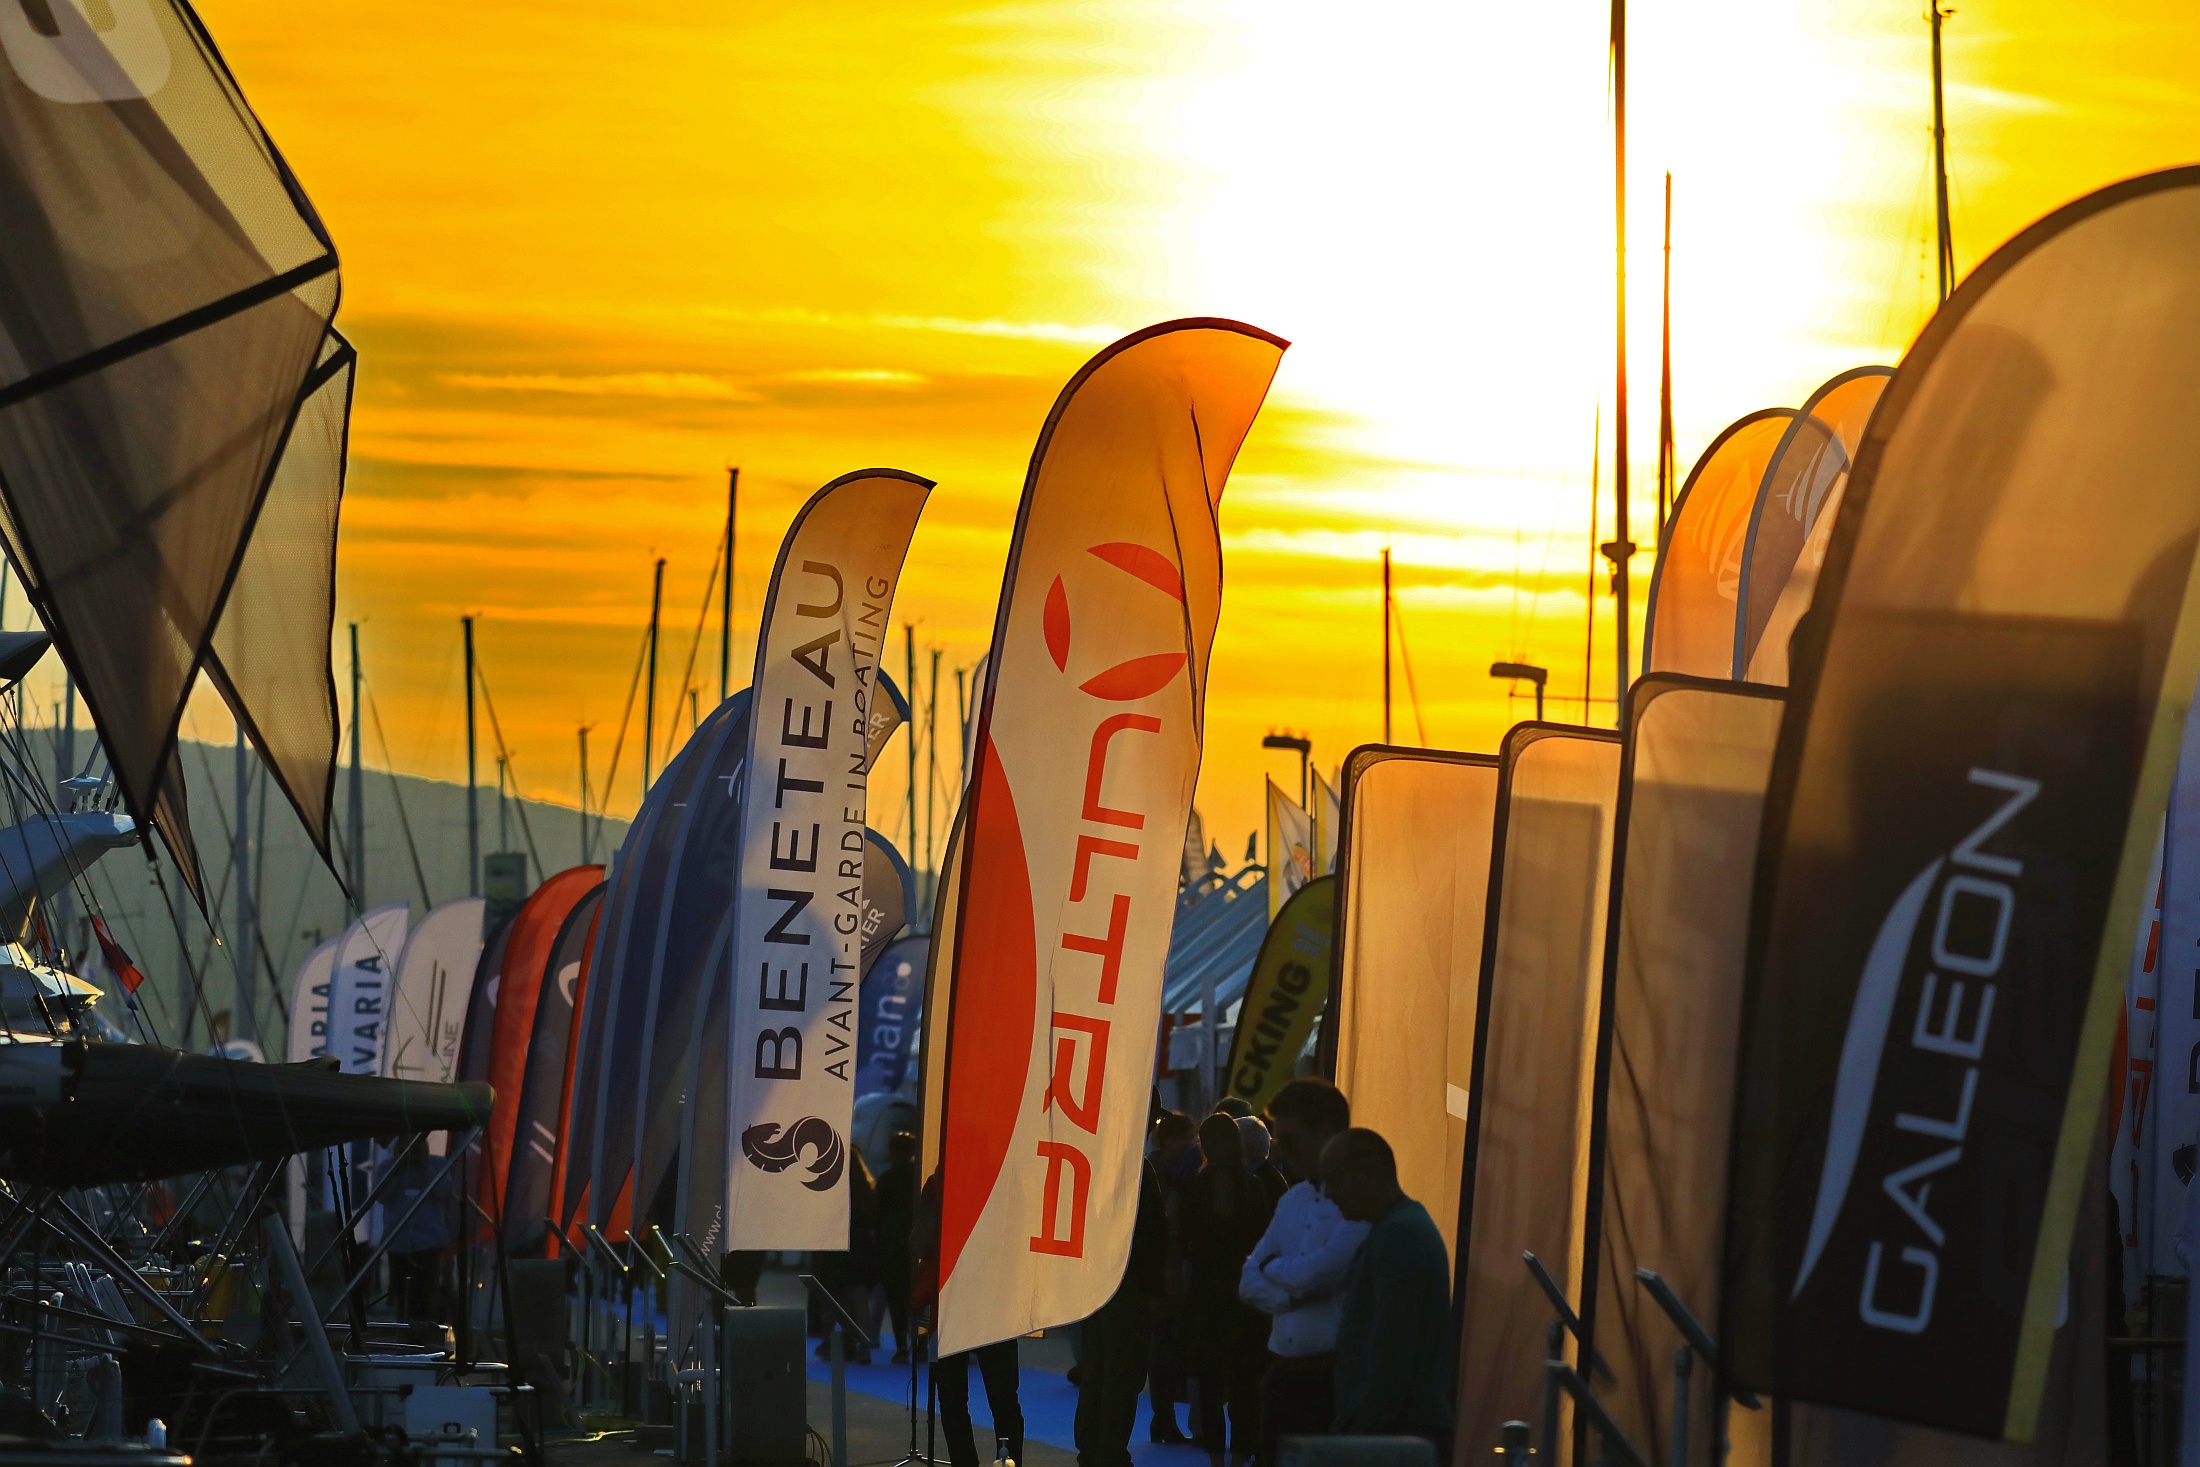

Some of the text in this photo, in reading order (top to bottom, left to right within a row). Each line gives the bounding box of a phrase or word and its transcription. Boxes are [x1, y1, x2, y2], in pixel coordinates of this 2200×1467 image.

[755, 560, 844, 1080] BENETEAU
[824, 575, 889, 1081] AVANT-GARDE IN BOATING
[1029, 713, 1162, 1258] ULTRA
[1860, 767, 2042, 1334] GALEON
